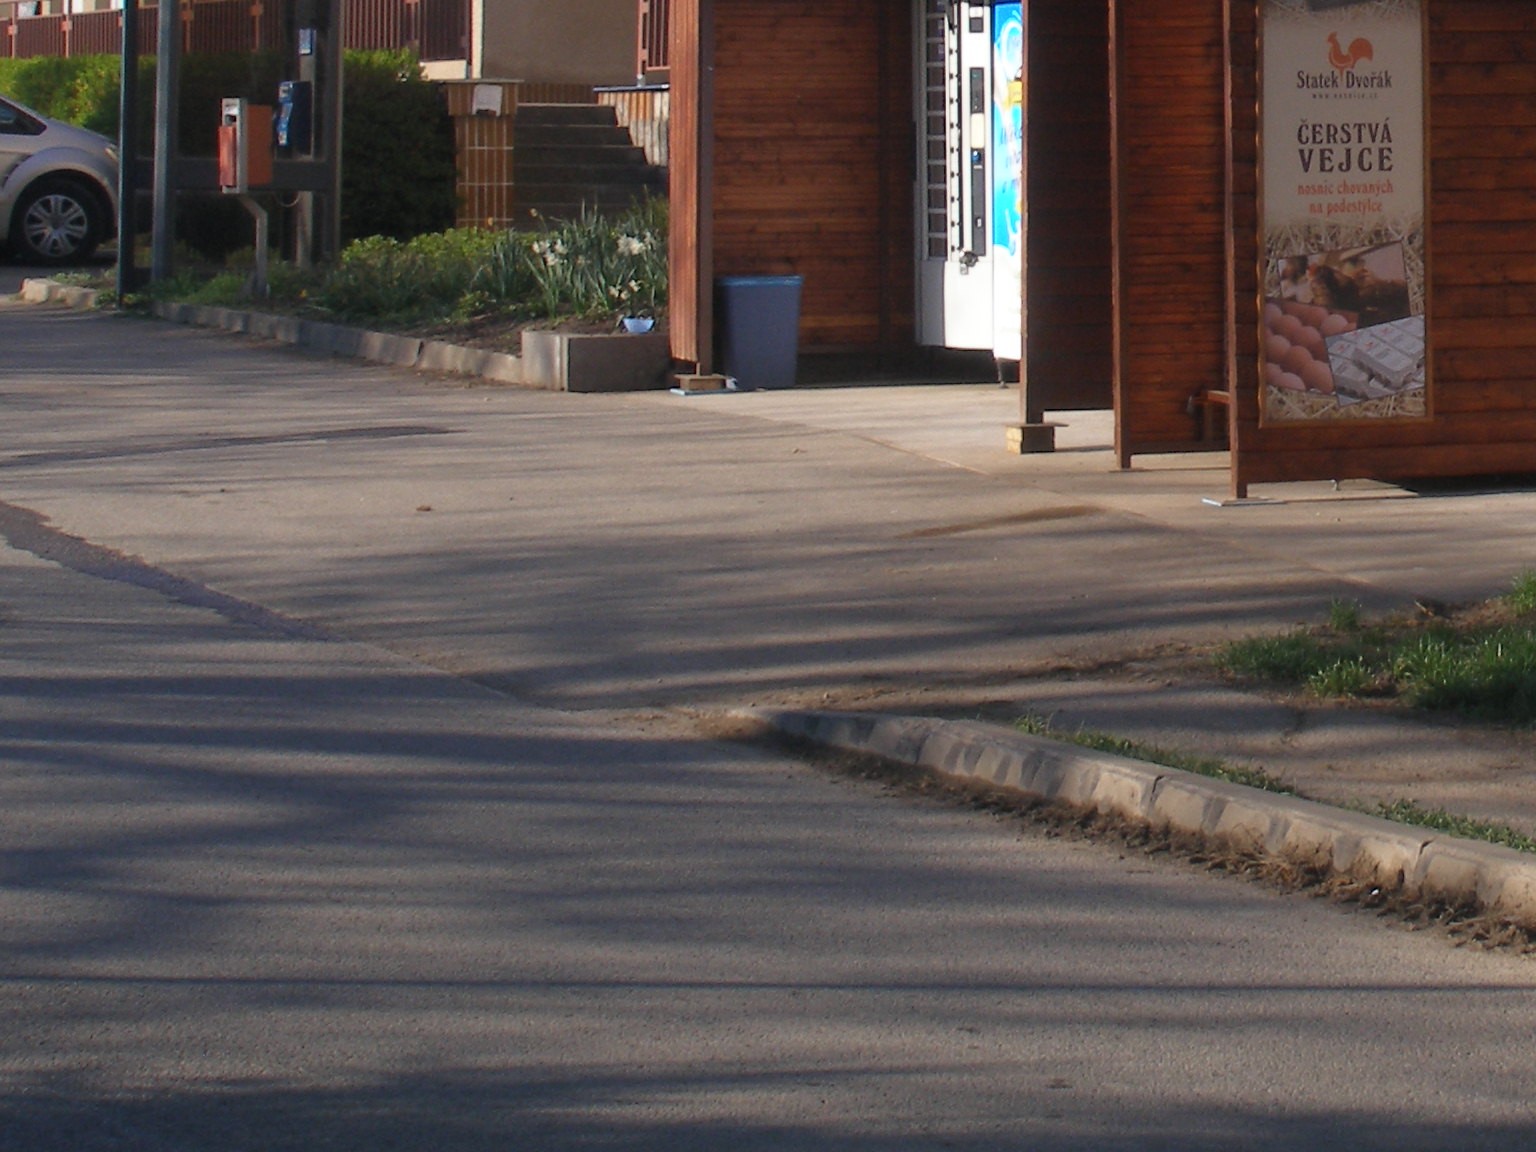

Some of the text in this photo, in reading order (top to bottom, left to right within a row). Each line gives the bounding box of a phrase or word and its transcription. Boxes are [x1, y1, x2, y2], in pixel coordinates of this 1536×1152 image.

[1296, 69, 1393, 89] Statek Dvořák
[1297, 117, 1393, 145] ČERSTVÁ
[1298, 147, 1394, 174] VEJCE
[1296, 178, 1394, 197] nosnic chovaných
[1309, 198, 1383, 217] na podestýlce
